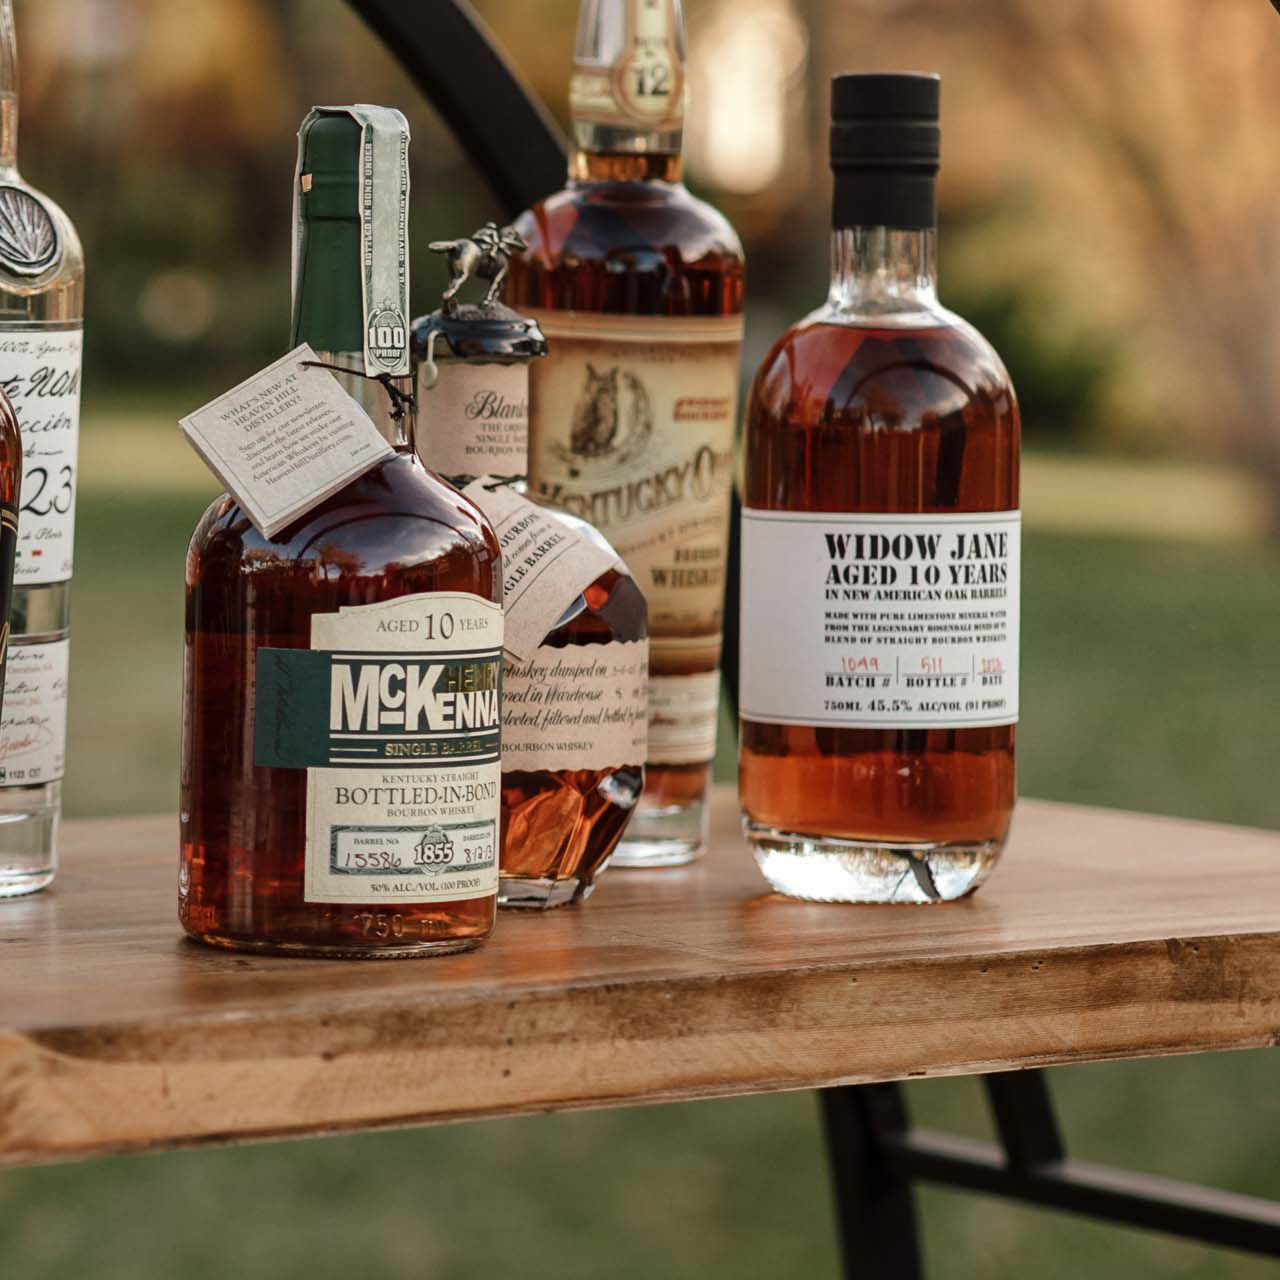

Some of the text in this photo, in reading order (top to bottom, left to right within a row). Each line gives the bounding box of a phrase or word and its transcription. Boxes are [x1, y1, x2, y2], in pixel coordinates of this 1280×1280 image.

[634, 67, 669, 96] 12
[364, 143, 373, 266] BOTTLED IN BOND UNDER
[368, 326, 405, 350] 100
[376, 349, 401, 359] PROOF
[259, 381, 283, 399] NEW
[284, 374, 297, 385] AT
[235, 385, 298, 426] HEAVEN HILL
[500, 513, 540, 548] OURBON
[825, 532, 1008, 560] WIDOW JANE
[503, 533, 567, 596] GLE BARREL
[825, 562, 1007, 586] AGED 10 YEARS
[825, 587, 1007, 601] IN NEW AMERICAN OAK BARRELS
[376, 612, 488, 640] AGED 10 YEARS
[825, 612, 849, 620] MADE
[852, 612, 877, 620] WITH
[880, 612, 905, 620] PURE
[908, 612, 956, 620] LIMESTONE
[958, 611, 988, 619] MINERAL
[825, 624, 849, 632] FROM
[852, 624, 869, 632] THE
[872, 624, 925, 632] LEGENDARY
[927, 624, 972, 632] ROSENDALE
[825, 636, 857, 644] BLEND
[860, 636, 873, 644] OF
[876, 636, 928, 645] STRAIGHT
[931, 636, 973, 644] BOURBON
[445, 661, 501, 692] HENRY
[550, 659, 597, 684] dumped
[825, 676, 876, 688] BATCH
[906, 676, 956, 688] BOTTLE
[981, 675, 1002, 686] DATE
[530, 686, 542, 703] in
[542, 683, 604, 705] Warehouse
[824, 701, 862, 711] 750ML
[868, 699, 912, 712] 45.5%
[918, 701, 962, 712] ALC/VOL
[540, 708, 584, 731] filtered
[581, 706, 602, 725] and
[385, 740, 482, 756] SINGLE BARREL
[502, 741, 594, 752] BOURBON WHISKEY
[382, 772, 480, 784] KENTUCKY STRAIGHT
[387, 805, 475, 817] BOURBON WHISKEY
[414, 841, 455, 866] 1855
[370, 884, 390, 893] 50%
[456, 878, 481, 890] PROOF)
[360, 913, 404, 938] 750
